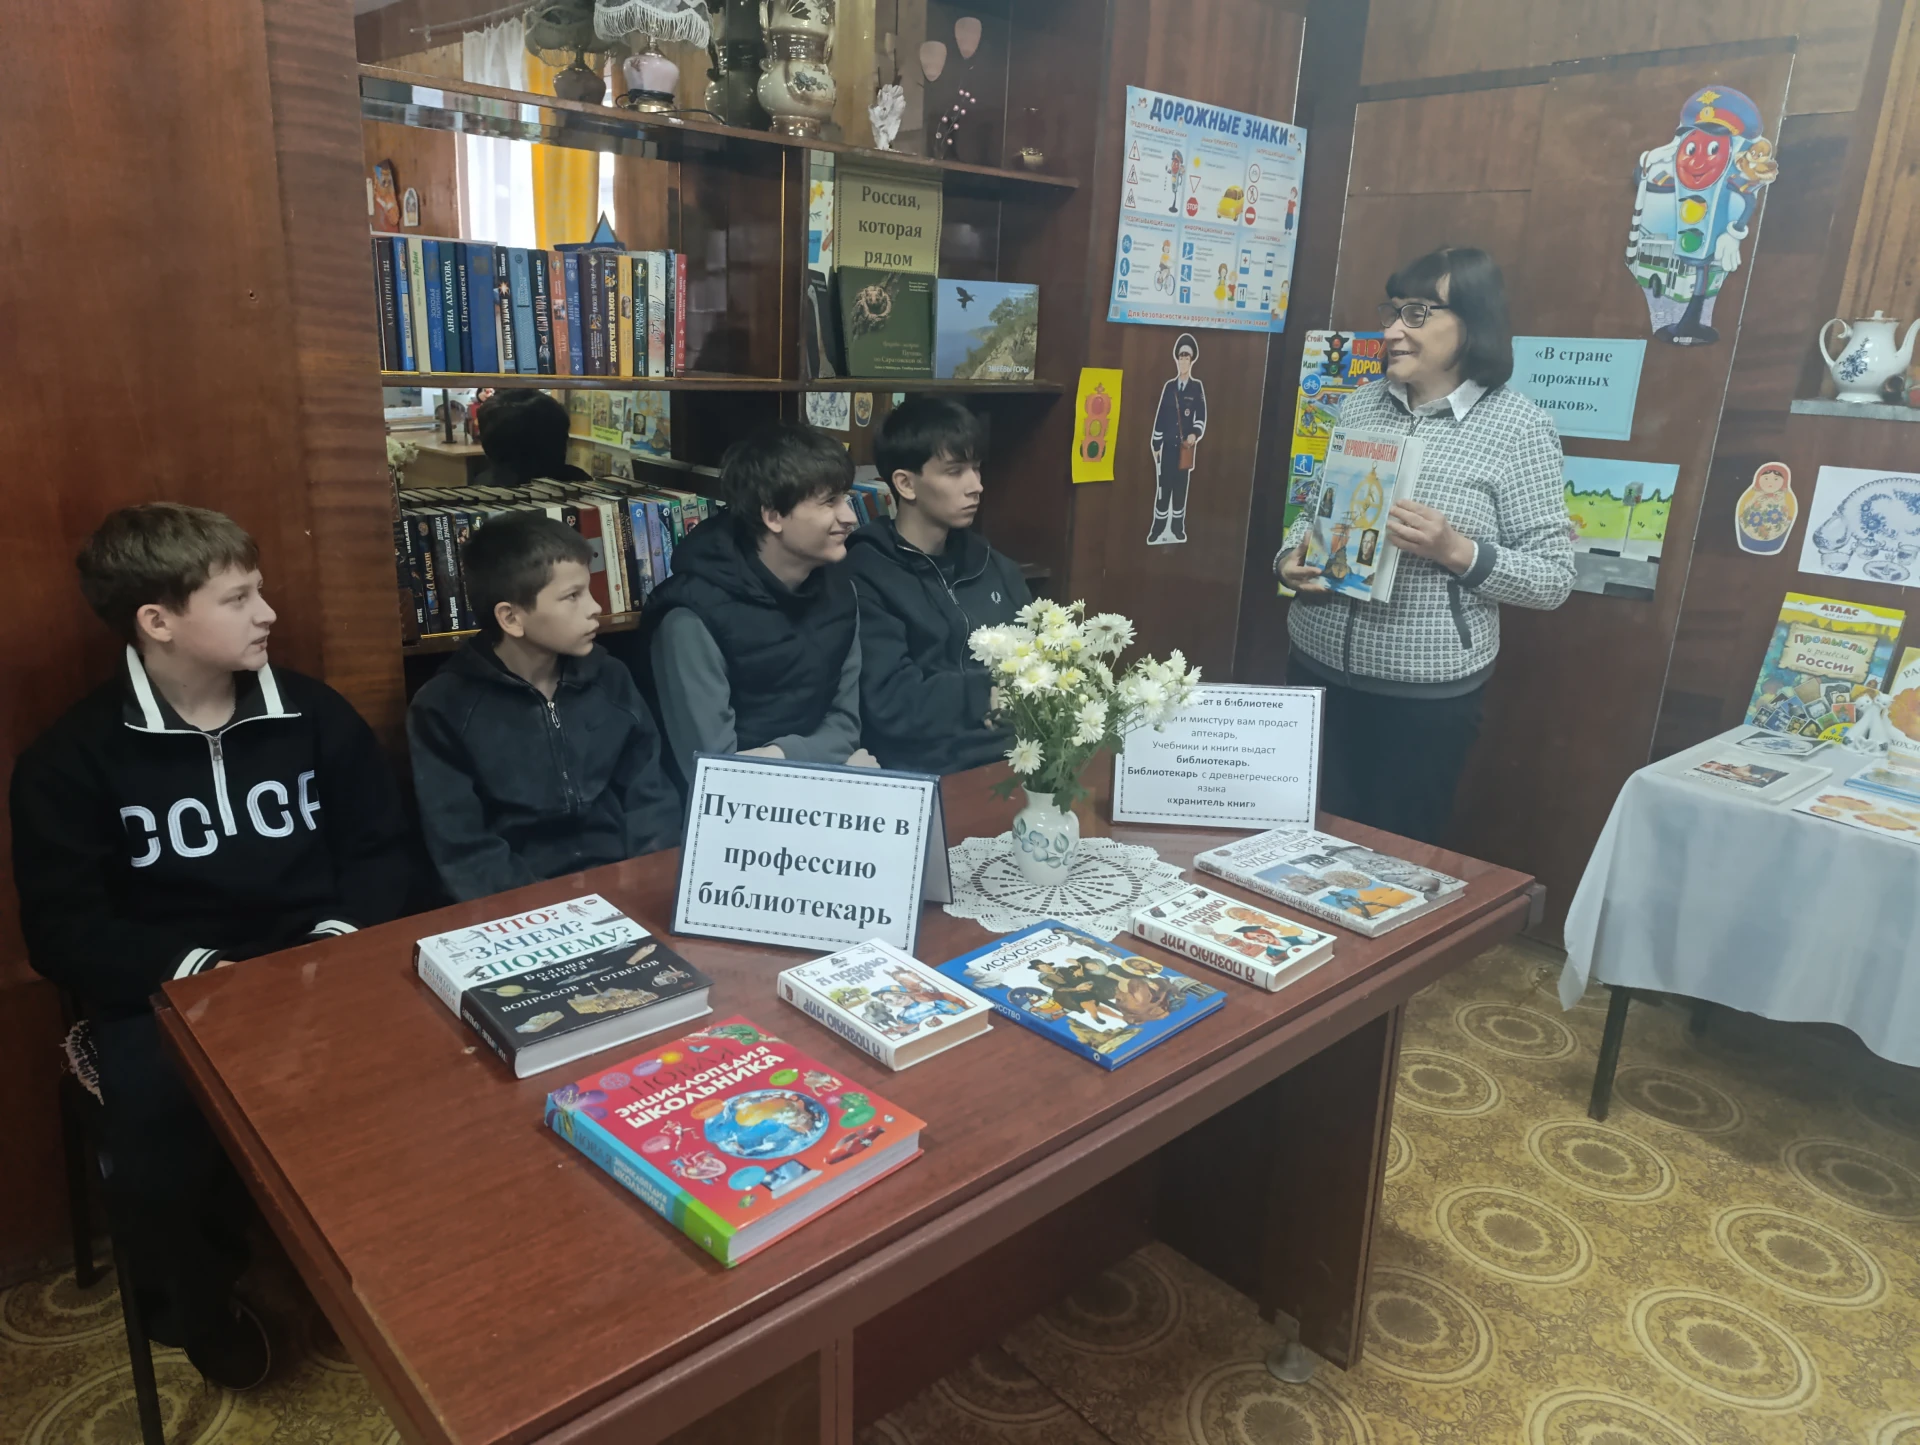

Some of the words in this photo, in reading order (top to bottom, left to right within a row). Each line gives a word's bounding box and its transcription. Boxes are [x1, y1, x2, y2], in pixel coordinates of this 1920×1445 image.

[1150, 97, 1242, 136] ДОРОЖНЫЕ
[1242, 120, 1289, 146] ЗНАКИ
[862, 185, 920, 211] Россия,
[859, 219, 922, 240] которая
[864, 250, 913, 268] рядом
[444, 260, 453, 305] АХМАТОВА
[459, 265, 468, 322] Паустовский
[446, 309, 455, 333] АННА
[502, 299, 510, 322] УДАЧИ
[1128, 310, 1140, 318] Для
[1142, 311, 1181, 320] безопасности
[608, 323, 617, 362] ХОДЯЧИЙ
[1306, 335, 1323, 343] Стой!
[1303, 361, 1318, 369] Иди!
[1535, 348, 1555, 362] «В
[1559, 350, 1613, 363] стране
[1528, 372, 1609, 389] дорожных
[1344, 439, 1398, 462] ПЕРВООТКРЫВАТЕЛИ
[424, 552, 434, 580] Мазин
[1821, 604, 1859, 616] АТЛАС
[1794, 634, 1868, 655] Промыслы
[1796, 653, 1854, 673] РОССИИ
[1903, 667, 1920, 678] РА
[1224, 699, 1283, 709] библиотеке
[1189, 716, 1234, 726] микстуру
[1258, 720, 1298, 729] продаст
[1191, 730, 1238, 740] аптекарь,
[1153, 741, 1199, 751] Учебники
[1241, 747, 1276, 756] выдаст
[1176, 756, 1250, 768] библиотекарь.
[1127, 767, 1198, 779] Библиотекарь
[1209, 772, 1299, 783] древнегреческого
[1198, 785, 1226, 793] языка
[1167, 797, 1225, 808] «хранитель
[1228, 800, 1256, 808] книг»
[702, 793, 886, 834] Путешествие
[894, 819, 910, 836] в
[724, 846, 877, 879] профессию
[1235, 848, 1286, 869] ЧУДЕС
[1282, 836, 1329, 852] СВЕТА
[698, 881, 892, 930] библиотекарь
[1170, 919, 1188, 927] Я
[1181, 899, 1227, 922] ПОЗНАЮ
[1253, 882, 1302, 908] ЭНЦИКЛОПЕДИЯ
[1303, 903, 1322, 915] ЧУДЕС
[1322, 910, 1340, 921] СВЕТА
[483, 909, 558, 936] ЧТО?
[1200, 911, 1226, 925] МИР
[469, 920, 584, 960] ЗАЧЕМ?
[1160, 932, 1187, 952] МИР
[482, 926, 634, 978] ПОЧЕМУ?
[981, 934, 1061, 972] ИСКУССТВО
[999, 942, 1066, 973] ЭНЦИКЛОПЕДИЯ
[1189, 944, 1242, 978] ПОЗНАЮ
[524, 957, 595, 982] Большая
[816, 976, 832, 986] Я
[830, 957, 888, 981] ПОЗНАЮ
[846, 970, 876, 985] МИР
[1245, 966, 1255, 982] Я
[500, 984, 579, 1014] ВОПРОСОВ
[600, 959, 660, 983] ОТВЕТОВ
[803, 998, 825, 1020] МИР
[827, 1013, 871, 1052] ПОЗНАЮ
[873, 1043, 881, 1059] Я
[615, 1046, 770, 1118] ЭНЦИКЛОПЕДИЯ
[629, 1047, 734, 1096] НОВАЯ
[625, 1054, 785, 1129] ШКОЛЬНИКА
[613, 1166, 666, 1214] ШКОЛЬНИКА
